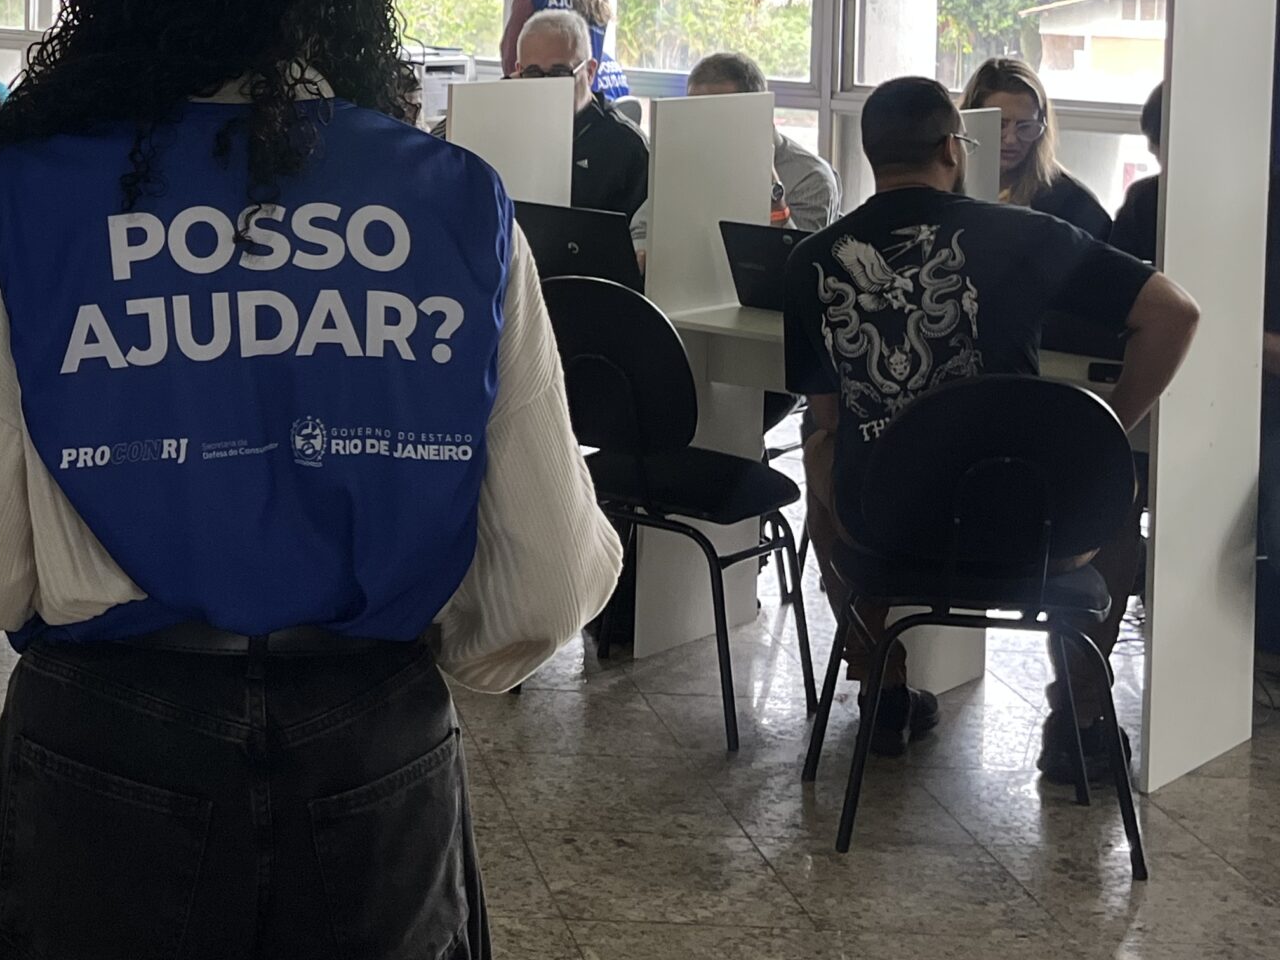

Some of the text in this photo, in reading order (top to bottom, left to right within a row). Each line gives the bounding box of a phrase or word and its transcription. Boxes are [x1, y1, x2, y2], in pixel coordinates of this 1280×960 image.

[107, 202, 412, 282] POSSO
[59, 289, 465, 374] AJUDAR?
[331, 427, 473, 443] GOVERNO DO ESTADO
[331, 438, 473, 461] RIO DE JANEIRO
